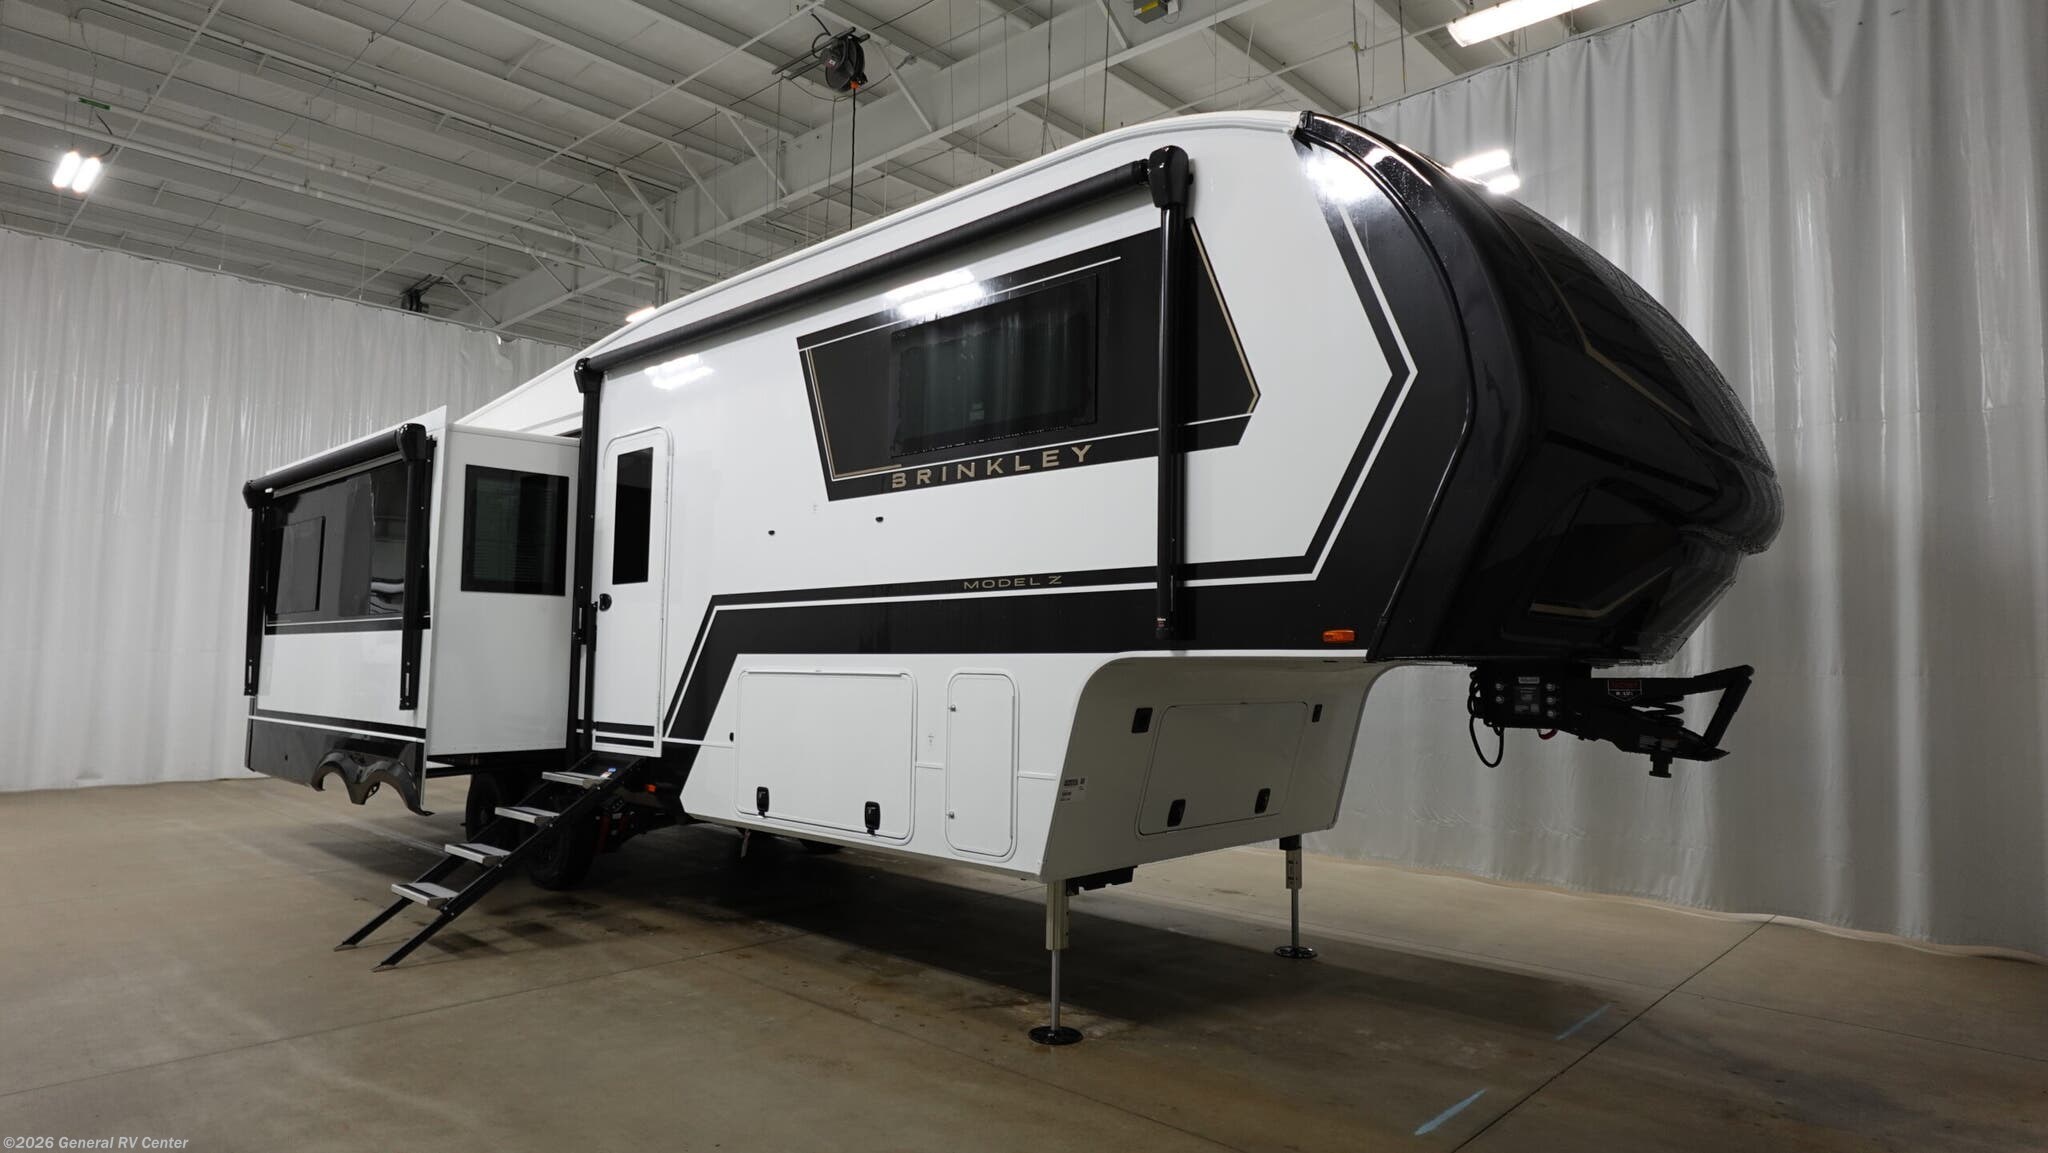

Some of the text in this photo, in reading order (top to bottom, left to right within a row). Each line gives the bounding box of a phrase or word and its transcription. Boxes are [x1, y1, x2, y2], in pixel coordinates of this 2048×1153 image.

[891, 444, 1093, 489] BRINKLEY
[963, 575, 1063, 590] MODEL Z
